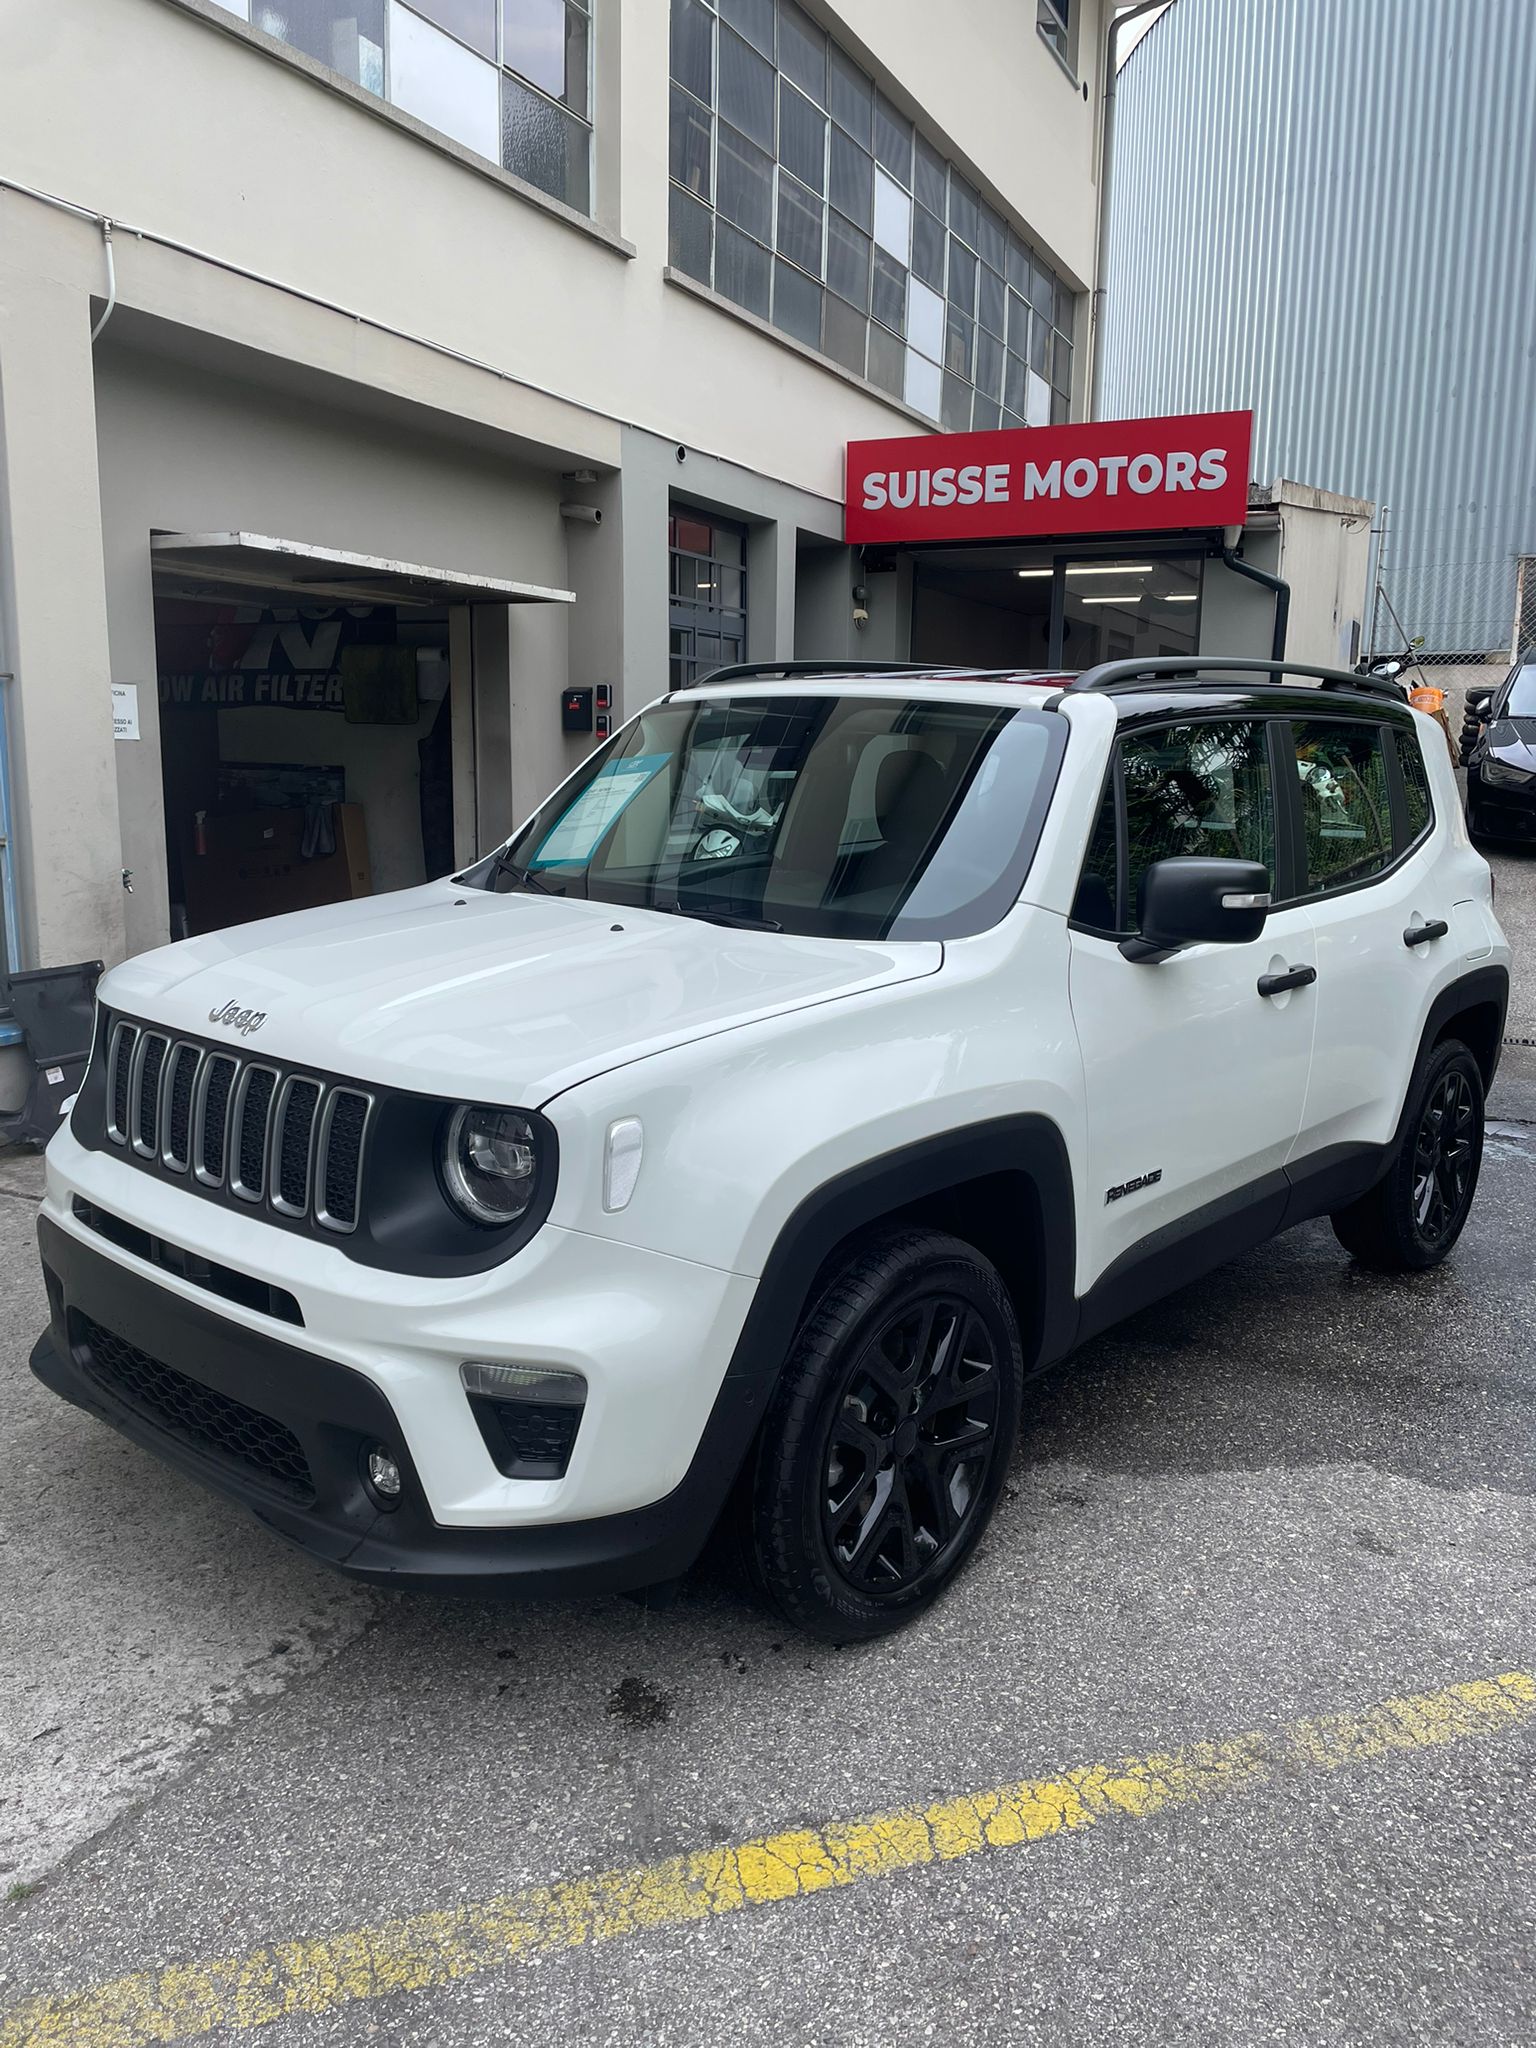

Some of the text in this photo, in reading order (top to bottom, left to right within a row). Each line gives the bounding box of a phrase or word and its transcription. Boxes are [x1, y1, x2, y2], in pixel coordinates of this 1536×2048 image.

[862, 448, 1229, 511] SUISSE MOTORS
[200, 674, 245, 703] AIR
[208, 998, 269, 1037] Jeep
[1103, 1168, 1163, 1207] RENEGADE
